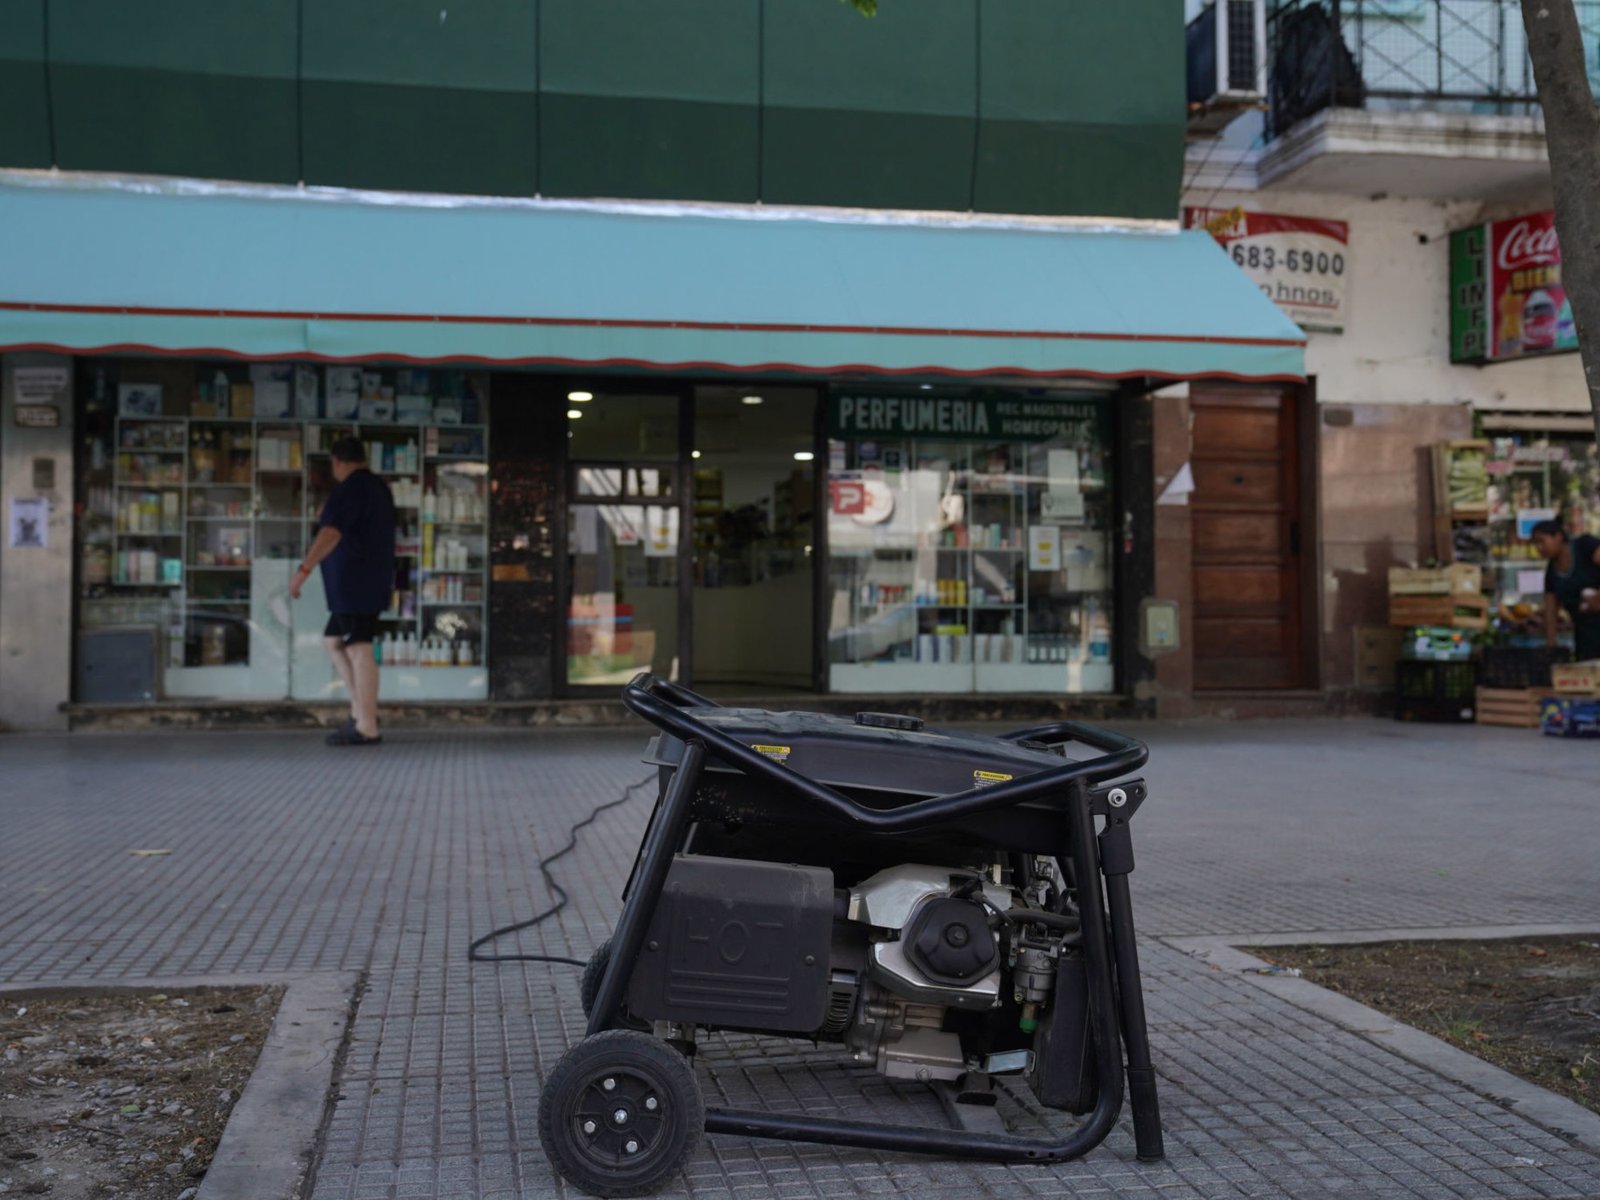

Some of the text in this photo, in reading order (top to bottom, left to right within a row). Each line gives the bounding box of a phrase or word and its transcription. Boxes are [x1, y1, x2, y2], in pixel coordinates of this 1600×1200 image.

[1222, 243, 1344, 276] 683-6900
[1498, 221, 1558, 269] Coca
[839, 397, 990, 433] PERFUMERIA
